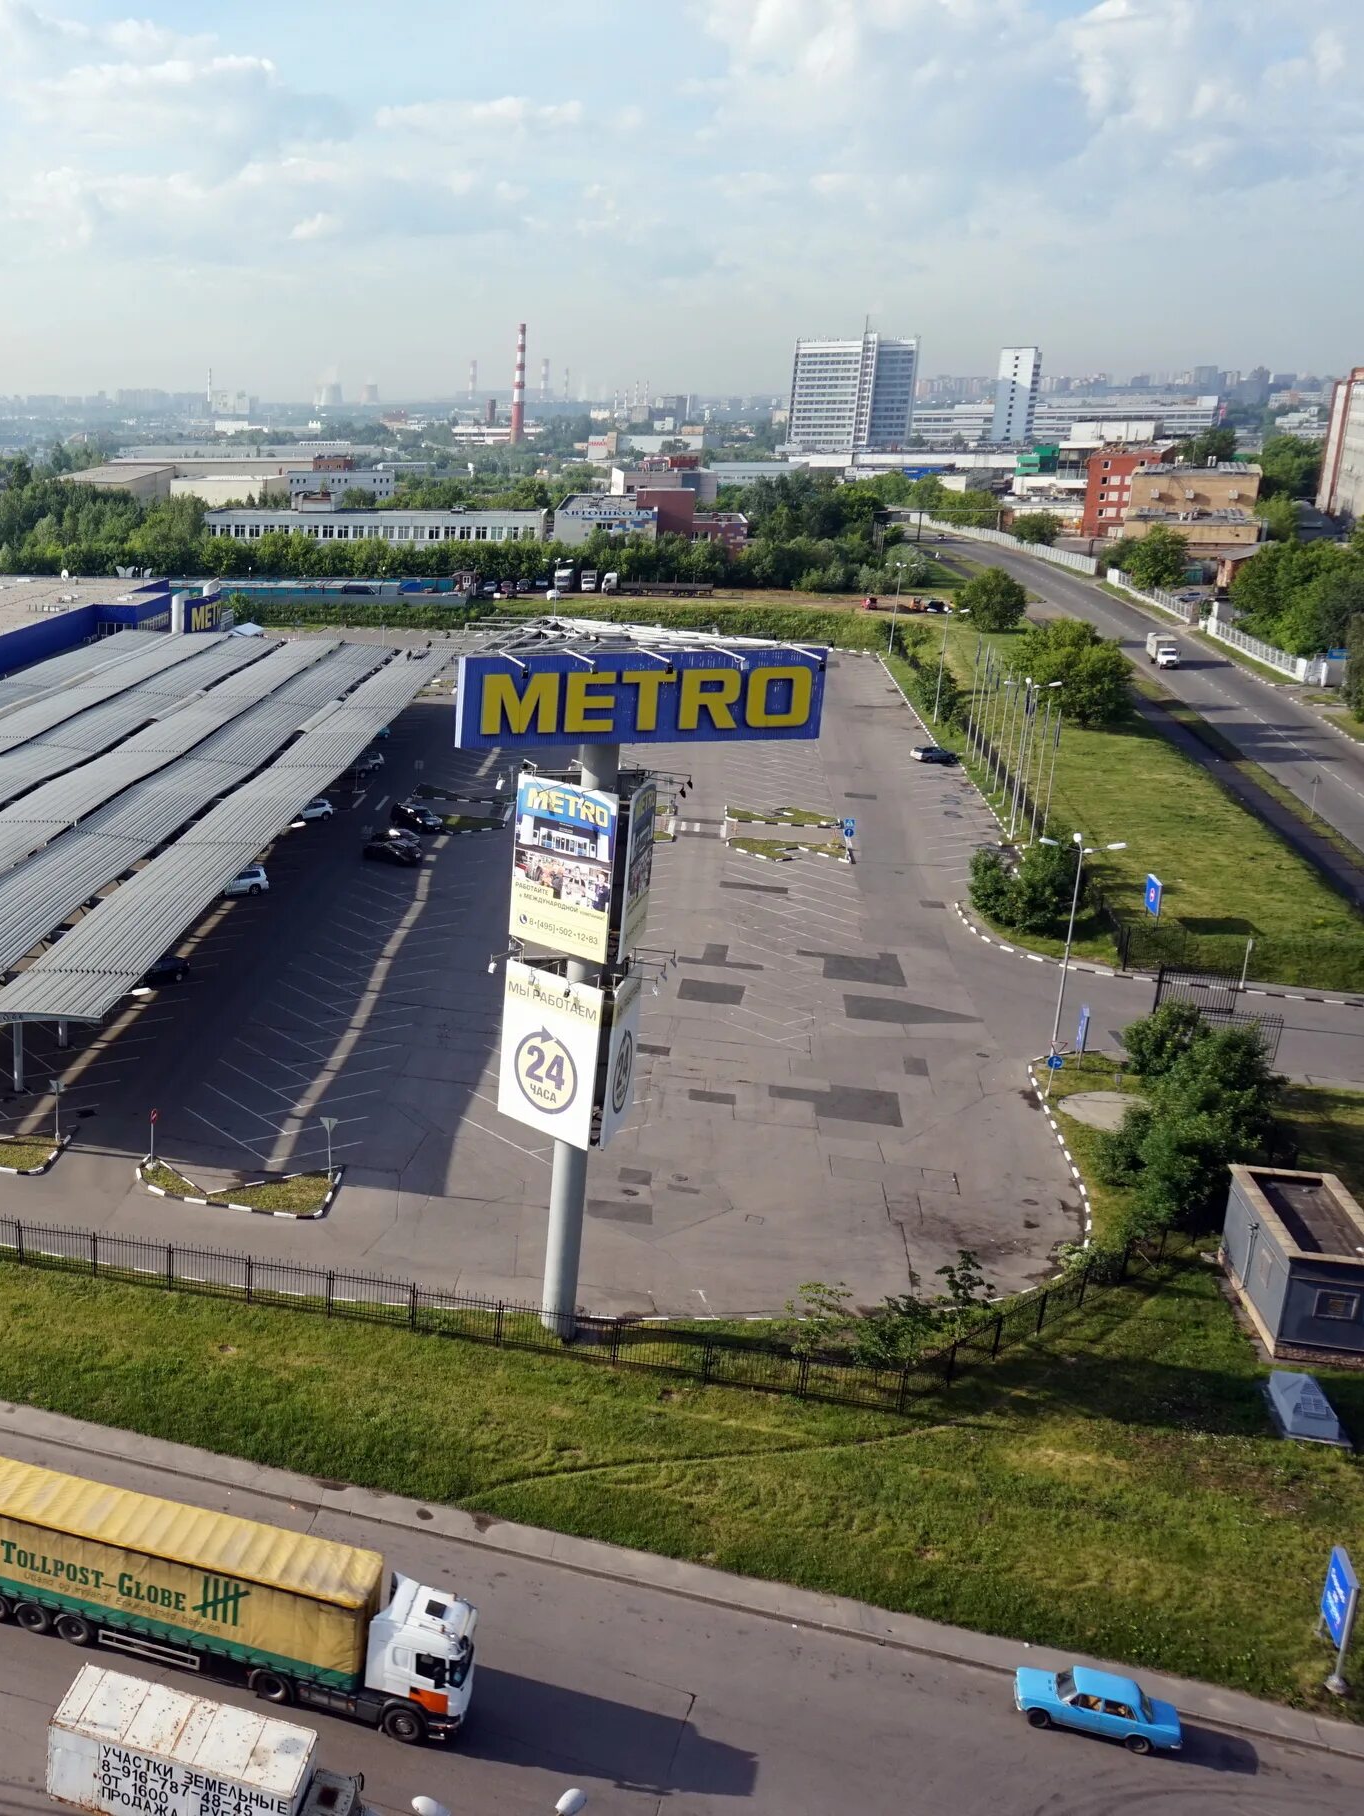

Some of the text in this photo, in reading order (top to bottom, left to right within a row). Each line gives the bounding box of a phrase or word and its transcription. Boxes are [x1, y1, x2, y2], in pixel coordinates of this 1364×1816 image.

[480, 666, 813, 735] METRO
[527, 788, 611, 828] METRO
[515, 881, 549, 896] РАБОТАЙТЕ
[524, 893, 578, 913] МЕЖДУНАРОДНОЙ
[508, 981, 529, 998] МЫ
[533, 989, 597, 1021] РАБОТАЕМ
[525, 1044, 565, 1091] 24
[530, 1083, 557, 1103] ЧАСА
[101, 1759, 253, 1816] 8-916-787-48-45
[102, 1773, 122, 1789] ОТ
[131, 1782, 169, 1804] 1600
[103, 1745, 288, 1815] УЧАСТКИ ЗЕМЕЛЬНЫЕ
